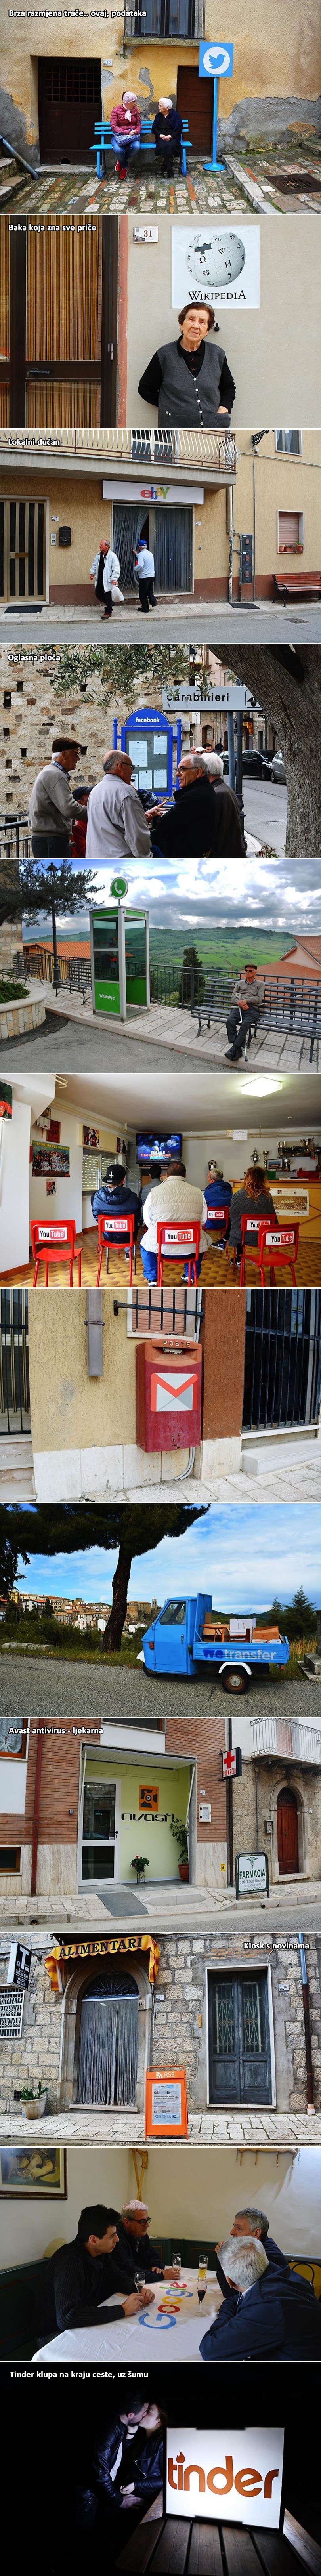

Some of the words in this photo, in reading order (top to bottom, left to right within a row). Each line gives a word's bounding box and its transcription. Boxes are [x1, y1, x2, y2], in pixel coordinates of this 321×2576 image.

[187, 290, 246, 300] WIKIPEDIA
[167, 693, 229, 702] carabinieri
[223, 1768, 236, 1776] FARMACIA
[239, 1869, 266, 1879] FARMACIA
[59, 1937, 142, 1957] ALIMENTARI
[20, 1946, 30, 1970] T
[16, 1969, 28, 1979] TABACCHI
[138, 2282, 194, 2329] Google
[168, 2450, 279, 2499] tinder
